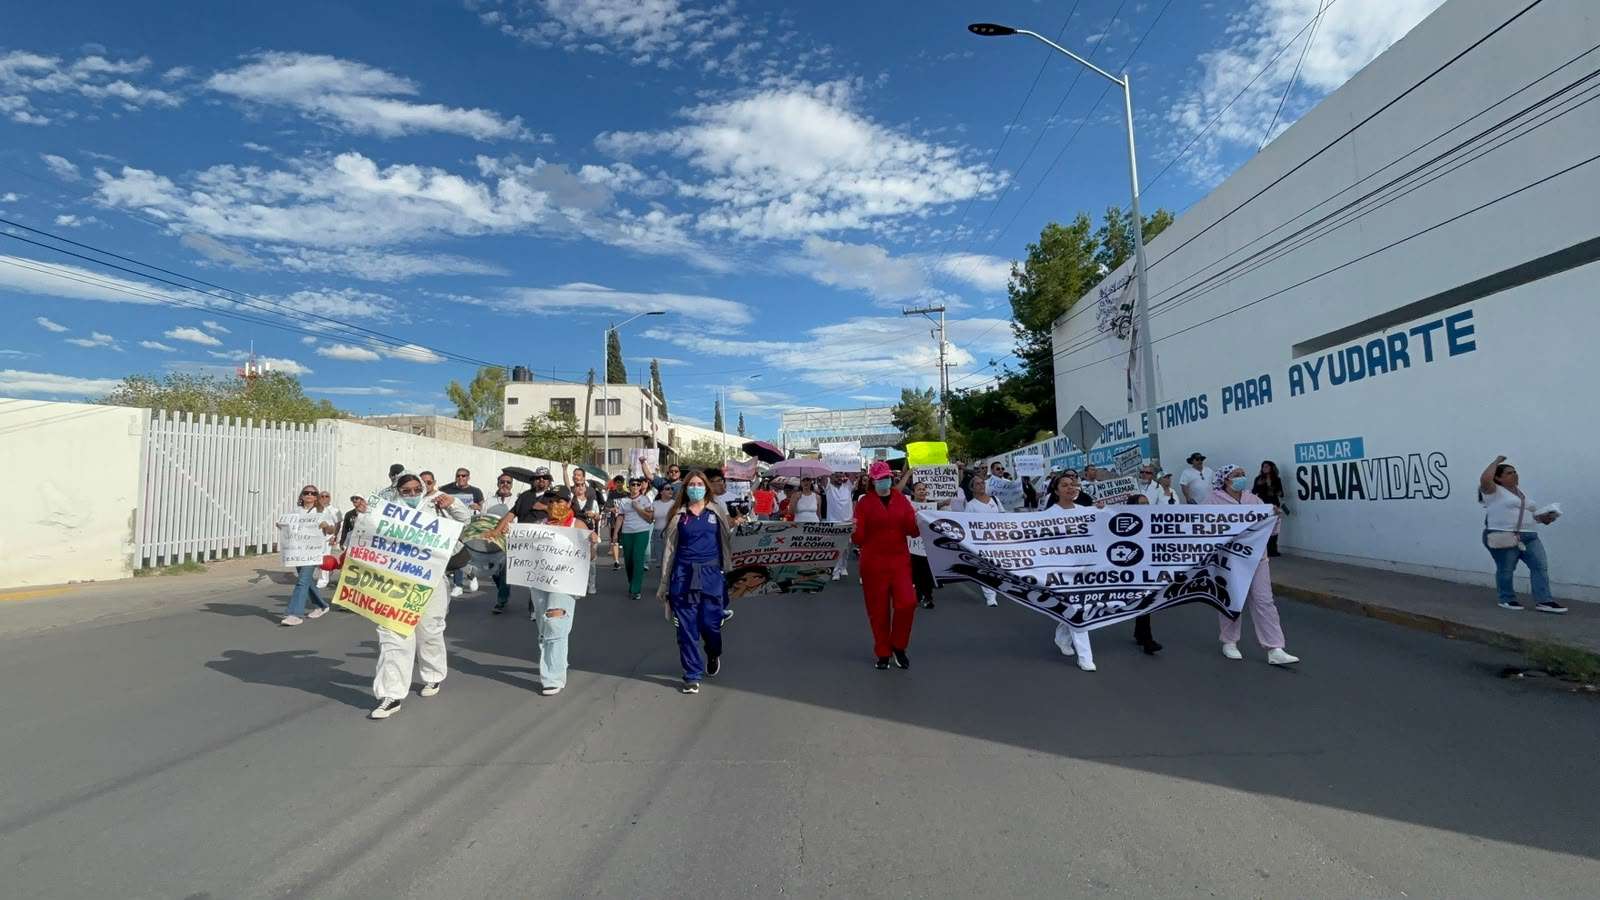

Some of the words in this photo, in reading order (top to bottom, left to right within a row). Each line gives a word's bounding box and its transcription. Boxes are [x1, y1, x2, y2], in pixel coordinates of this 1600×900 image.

[1141, 393, 1209, 434] ETAMOS
[1222, 373, 1272, 414] PARA
[1289, 309, 1476, 397] AYUDARTE
[1299, 441, 1352, 461] HABLAR
[1107, 481, 1113, 489] TE
[1115, 478, 1132, 487] VAYAS
[1296, 452, 1450, 501] SALVAVIDAS
[382, 502, 409, 521] EN
[410, 510, 440, 534] LA
[968, 521, 1018, 530] MEJORES
[1021, 514, 1096, 529] CONDICIONES
[375, 519, 451, 549] PANDEMIA
[802, 526, 853, 534] TORUNDAS
[971, 524, 1089, 542] LABORALES
[1151, 524, 1186, 535] DEL
[1192, 524, 1232, 535] RJP
[371, 535, 433, 561] ERAMOS
[978, 549, 1037, 559] AUMENTO
[1039, 544, 1098, 555] SALARIAL
[507, 556, 533, 570] TRATO
[344, 564, 412, 599] SOMOS
[1046, 571, 1070, 587] AL
[1073, 569, 1135, 586] ACOSO
[339, 585, 420, 626] DELINCUENTES
[1069, 595, 1080, 604] es
[1085, 592, 1104, 605] por
